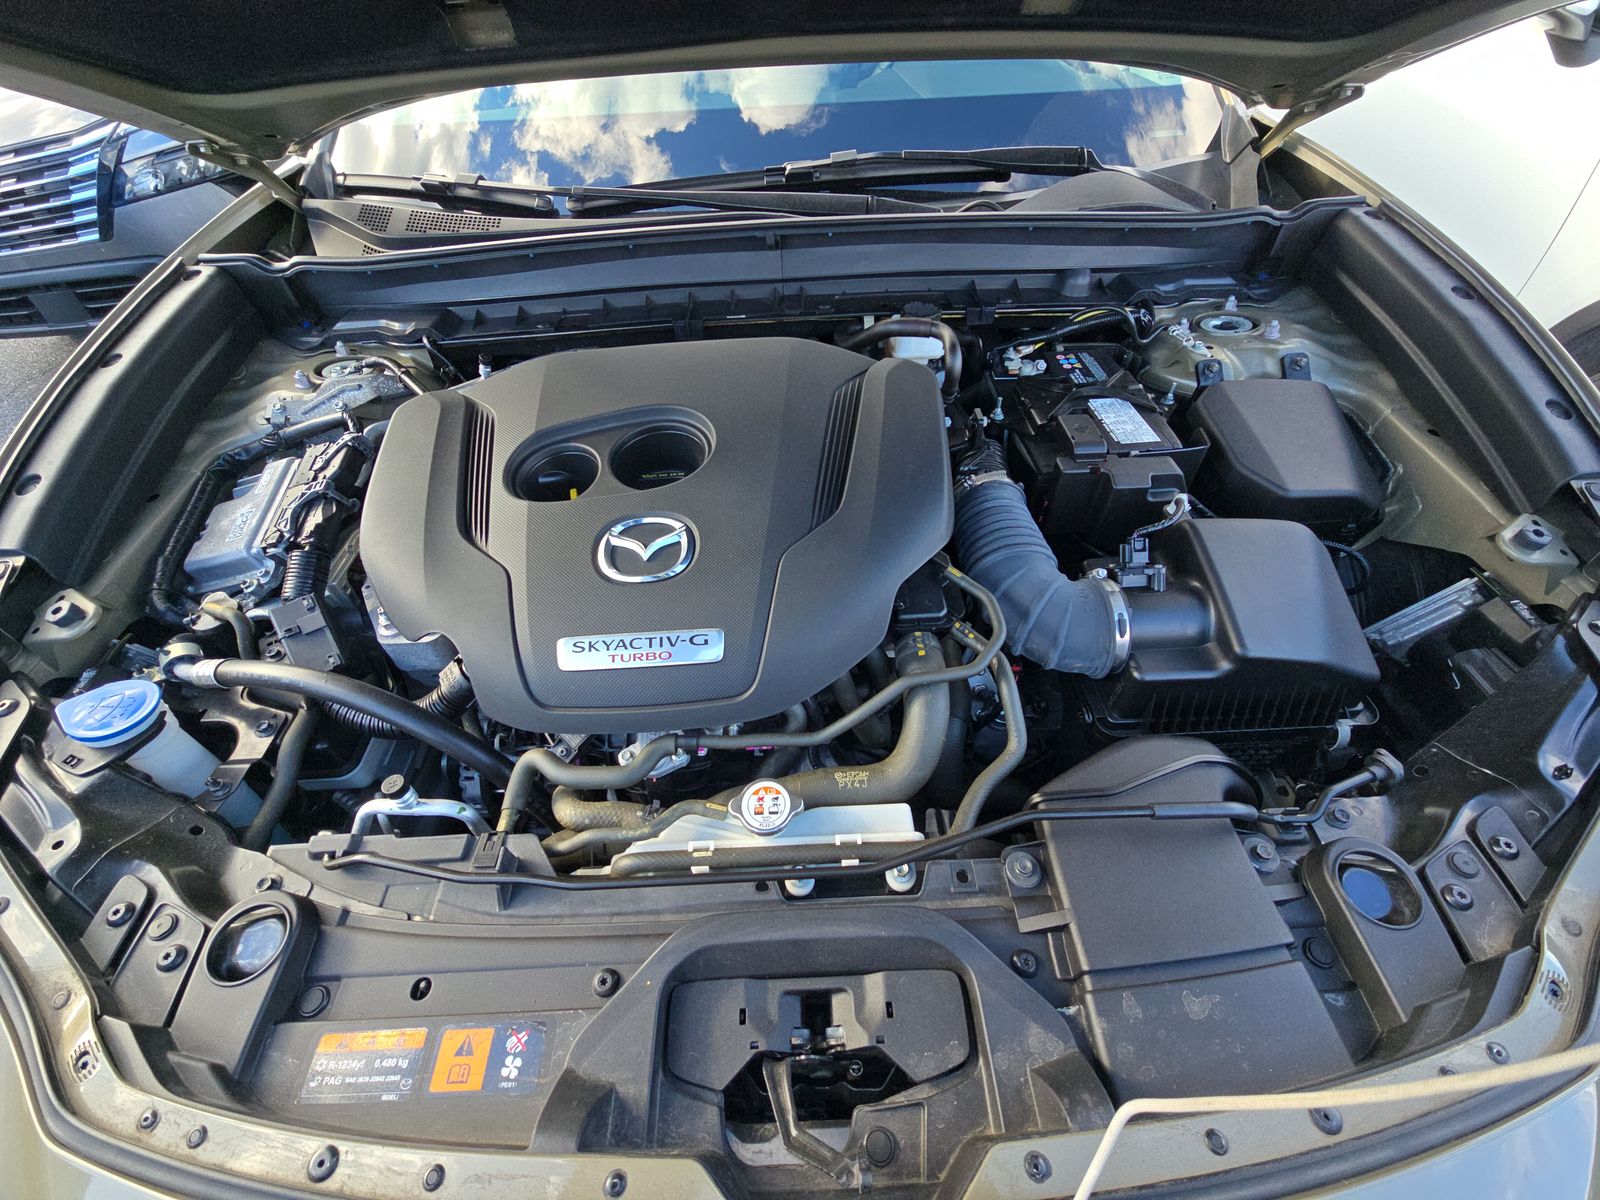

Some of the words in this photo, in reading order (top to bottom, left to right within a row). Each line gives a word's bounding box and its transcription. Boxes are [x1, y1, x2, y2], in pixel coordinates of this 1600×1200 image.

[572, 633, 708, 653] SKYACTIV-G
[608, 651, 673, 663] TURBO
[328, 1059, 365, 1070] R-1234yf
[397, 1057, 409, 1069] kg
[322, 1076, 342, 1086] PAG
